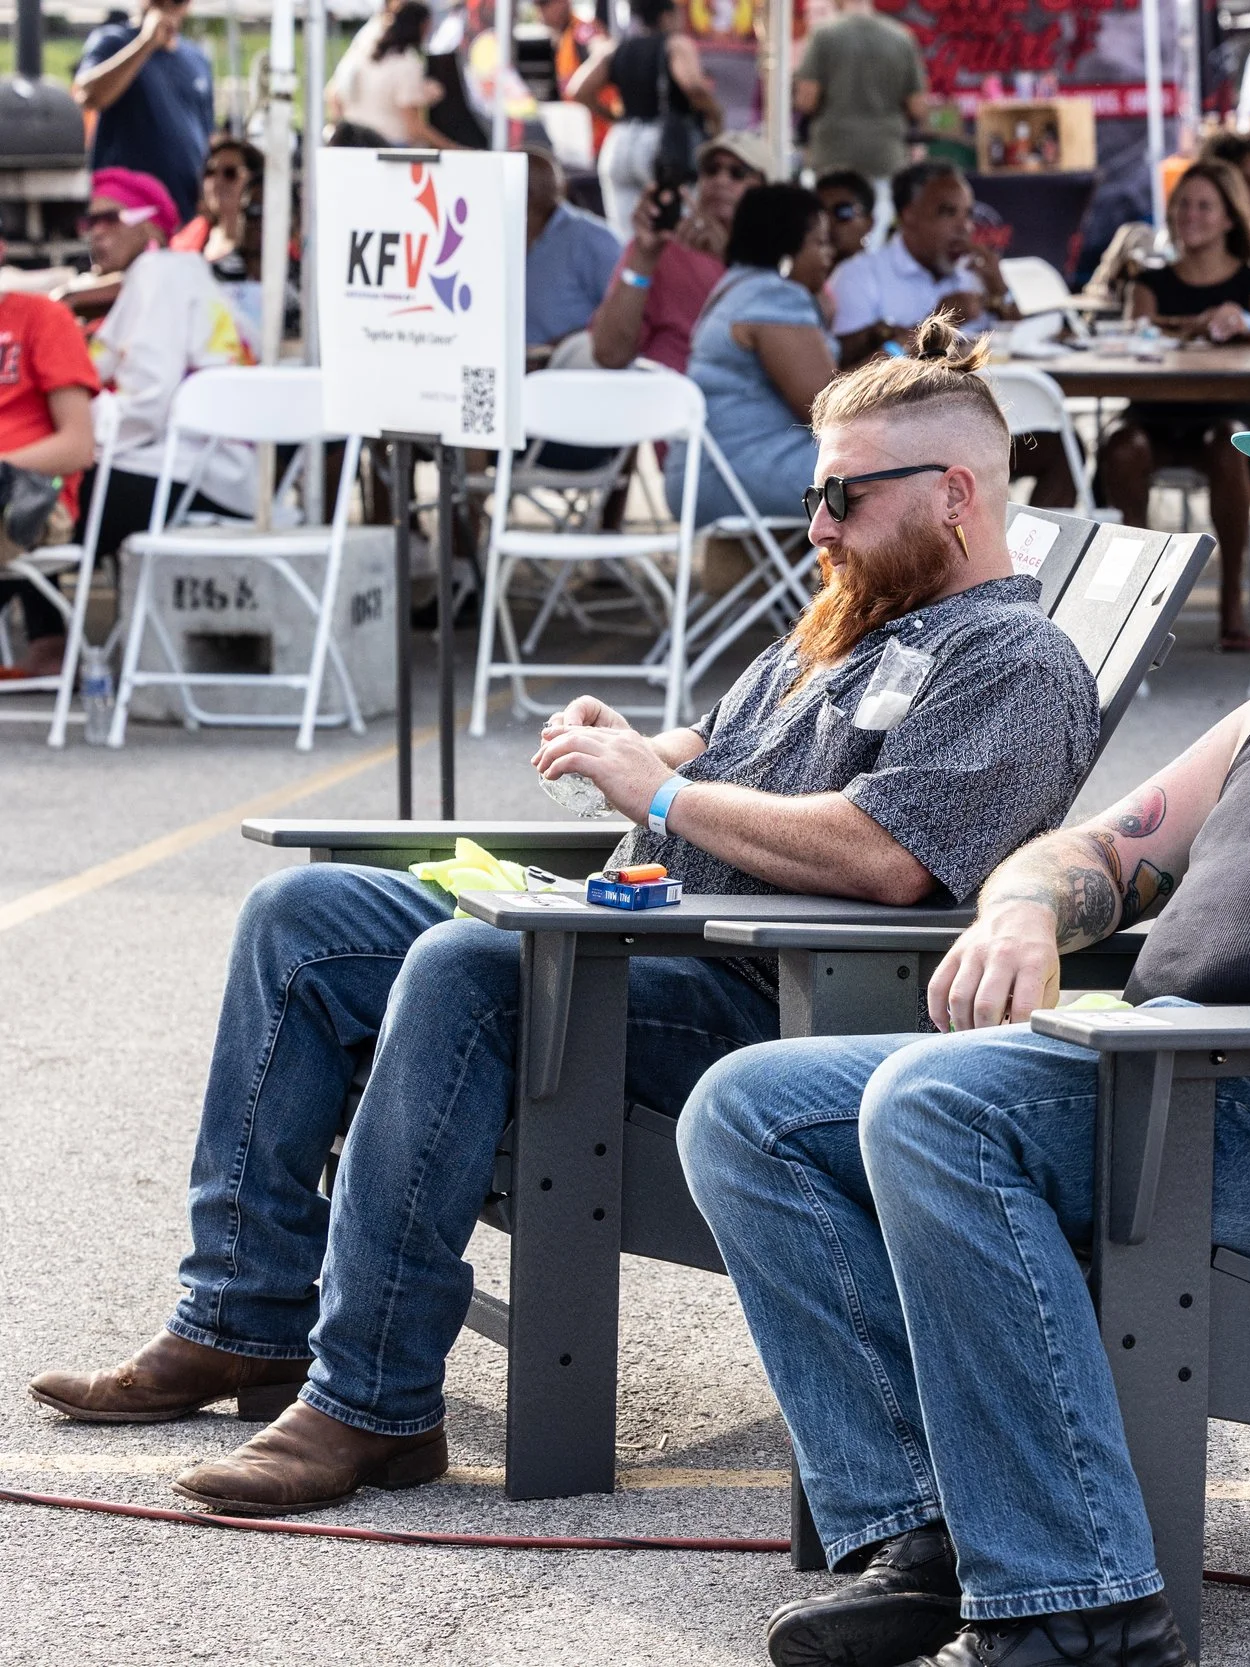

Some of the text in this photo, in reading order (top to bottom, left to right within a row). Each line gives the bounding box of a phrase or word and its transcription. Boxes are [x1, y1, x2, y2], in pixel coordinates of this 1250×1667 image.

[347, 231, 428, 289] KFV
[1008, 550, 1042, 568] ORAGE
[605, 890, 617, 901] MALL
[619, 892, 631, 903] PALL
